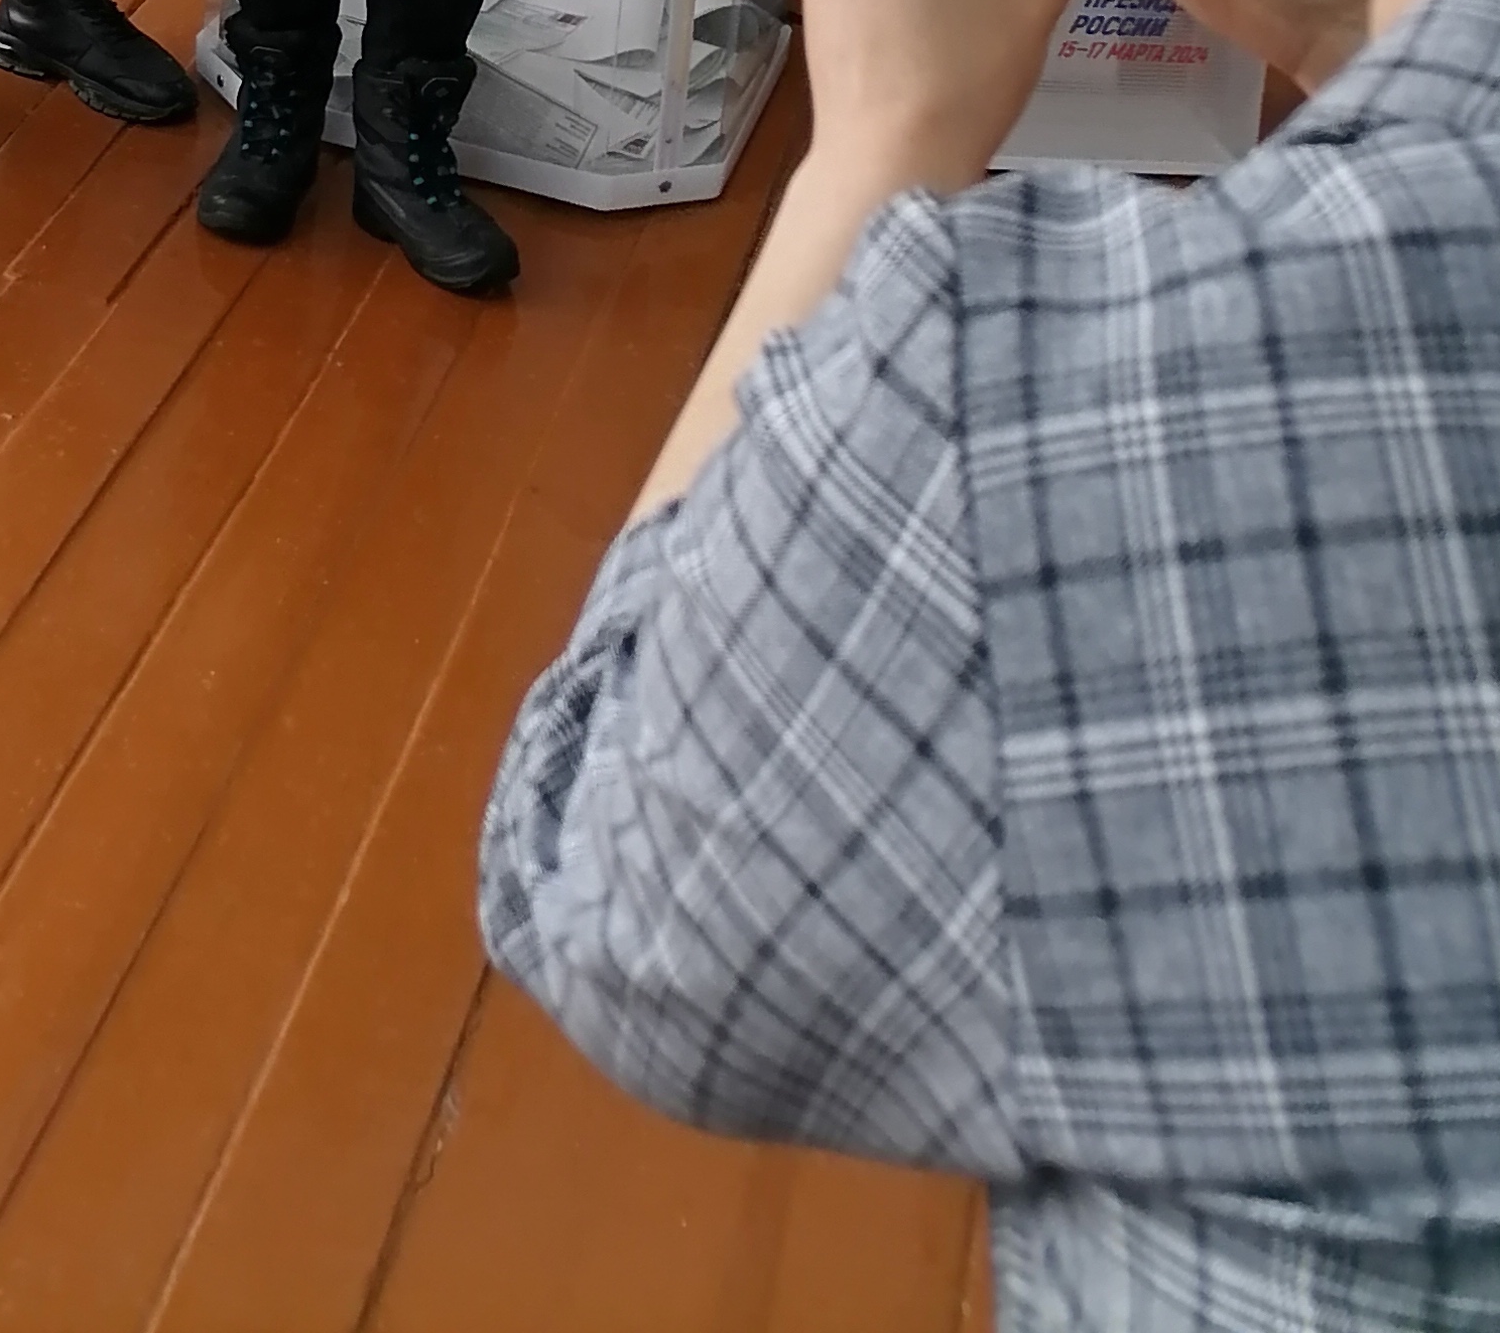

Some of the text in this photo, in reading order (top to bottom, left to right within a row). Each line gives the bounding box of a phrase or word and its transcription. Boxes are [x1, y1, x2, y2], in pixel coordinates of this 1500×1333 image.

[1068, 15, 1171, 37] РОССИИ
[1107, 41, 1165, 62] МАРТА
[1166, 44, 1210, 64] 2024
